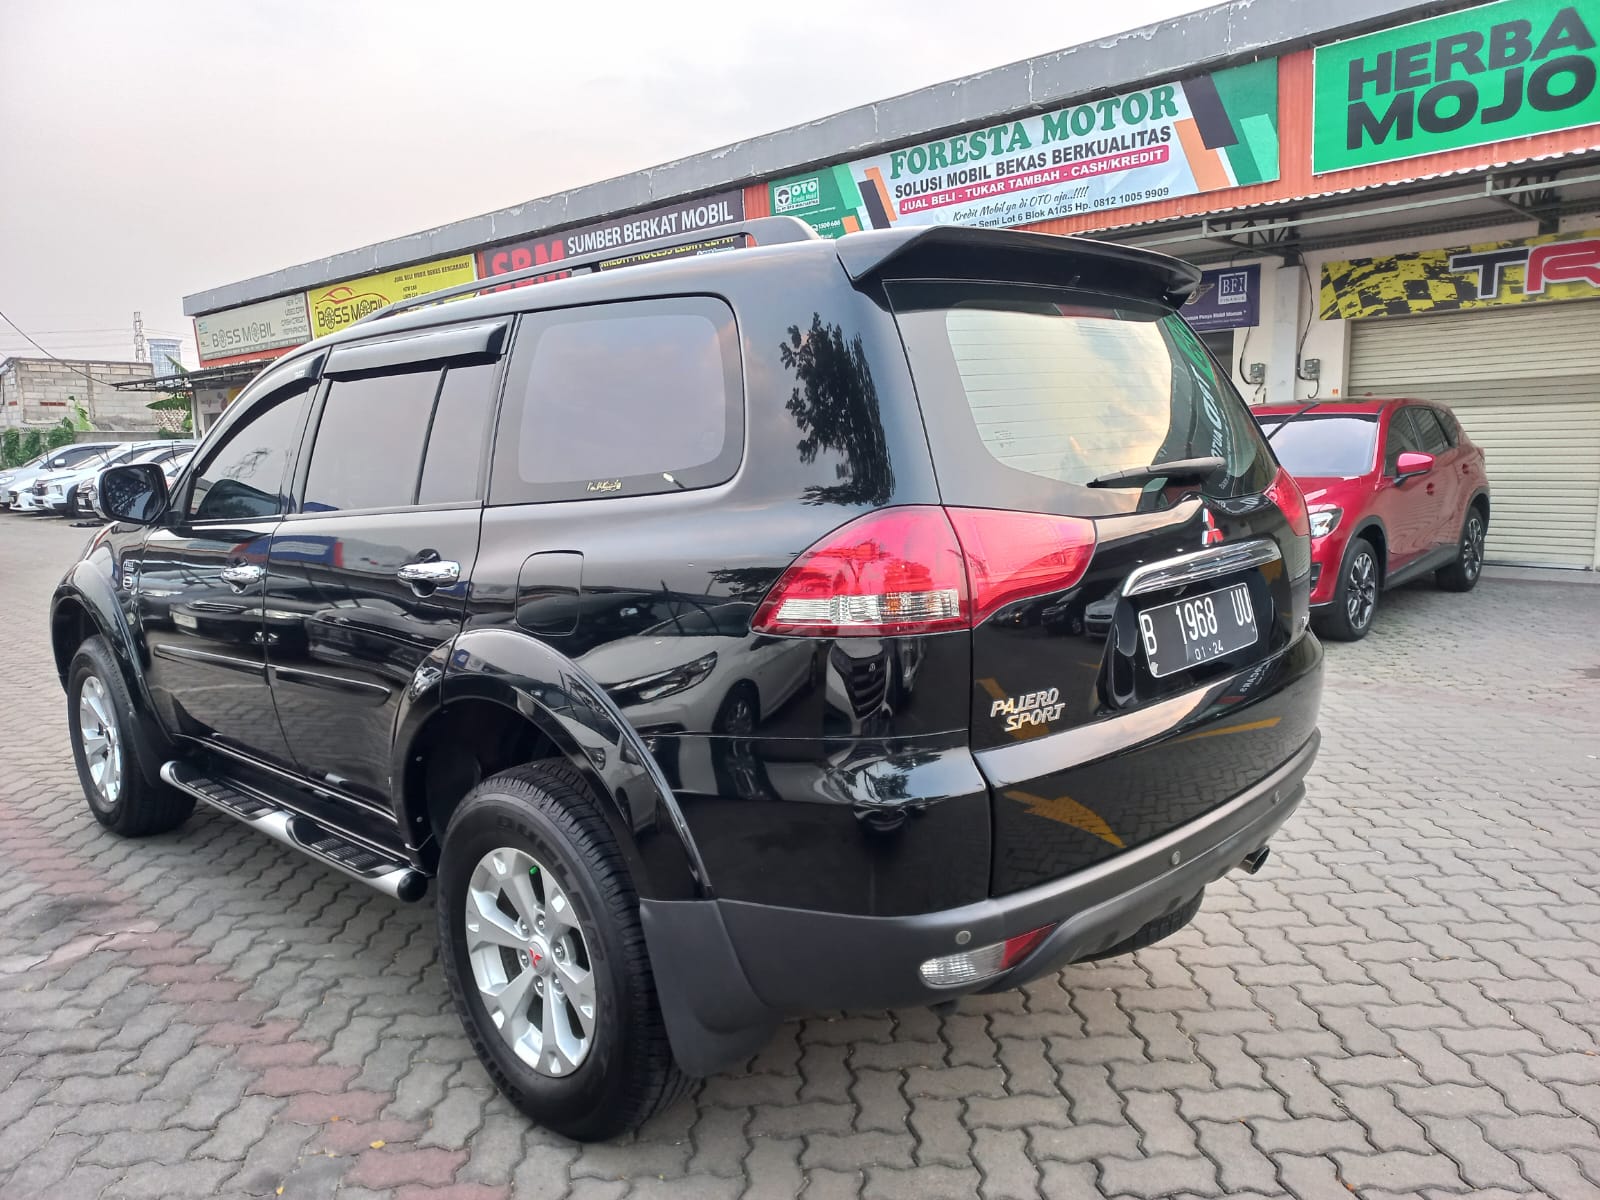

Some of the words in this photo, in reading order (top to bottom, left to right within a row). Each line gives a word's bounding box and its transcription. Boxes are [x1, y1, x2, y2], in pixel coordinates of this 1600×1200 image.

[1347, 6, 1597, 102] HERBA
[1346, 54, 1597, 151] MOJO
[889, 121, 1032, 180] FORESTA
[1041, 85, 1179, 146] MOTOR
[895, 175, 943, 200] SOLUSI
[946, 162, 991, 187] MOBIL
[995, 152, 1048, 176] BEKAS
[1051, 125, 1172, 166] BERKUALITAS
[901, 198, 929, 212] JUAL
[930, 191, 956, 207] BELI
[965, 181, 1005, 200] TUKAR
[1007, 169, 1060, 193] TAMBAH
[1071, 148, 1164, 178] CASH/KREDIT
[791, 181, 817, 196] OTO
[952, 206, 979, 223] Kredit
[979, 200, 1005, 217] Mobil
[1028, 193, 1052, 207] OTO
[979, 217, 1000, 229] Semi
[1001, 214, 1016, 225] Lot
[1017, 212, 1024, 222] 6
[1025, 209, 1047, 221] Blok
[1048, 203, 1073, 217] A1/35
[1075, 201, 1092, 214] Hp.
[1093, 196, 1117, 208] 0812
[1119, 191, 1143, 204] 1005
[1144, 186, 1170, 199] 9909
[567, 225, 622, 255] SUMBER
[623, 212, 679, 244] BERKAT
[681, 200, 734, 231] MOBIL
[1222, 277, 1244, 294] BFI
[212, 328, 241, 348] BOSS
[242, 321, 276, 343] MOBIL
[317, 305, 351, 330] BOSS
[1139, 613, 1158, 656] B
[1175, 597, 1218, 645] 1968
[1230, 587, 1253, 627] UU
[990, 687, 1060, 718] PAJERO
[1004, 702, 1066, 732] SPORT
